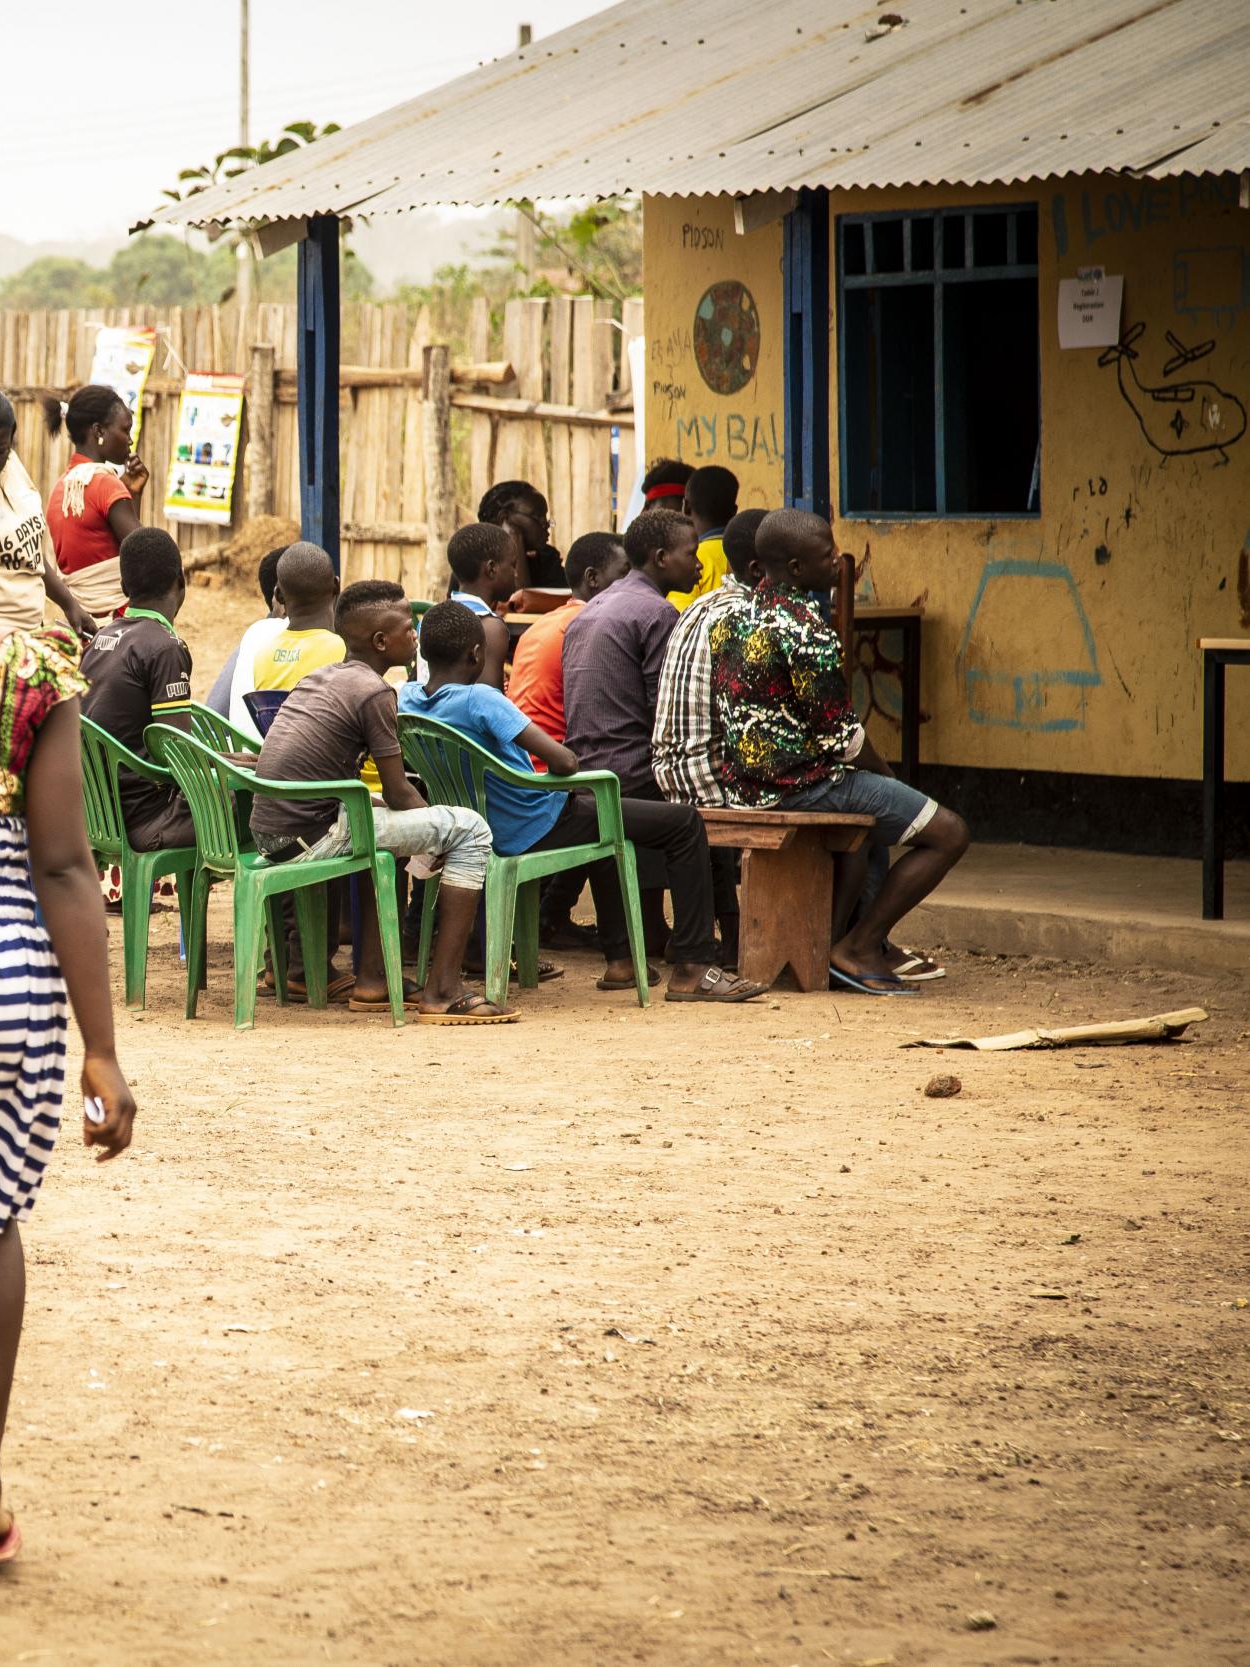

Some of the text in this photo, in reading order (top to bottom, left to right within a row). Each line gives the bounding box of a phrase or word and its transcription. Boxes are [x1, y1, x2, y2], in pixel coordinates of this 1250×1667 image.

[1081, 184, 1172, 248] LOVE
[676, 412, 717, 463] MY
[15, 516, 42, 543] DAYS
